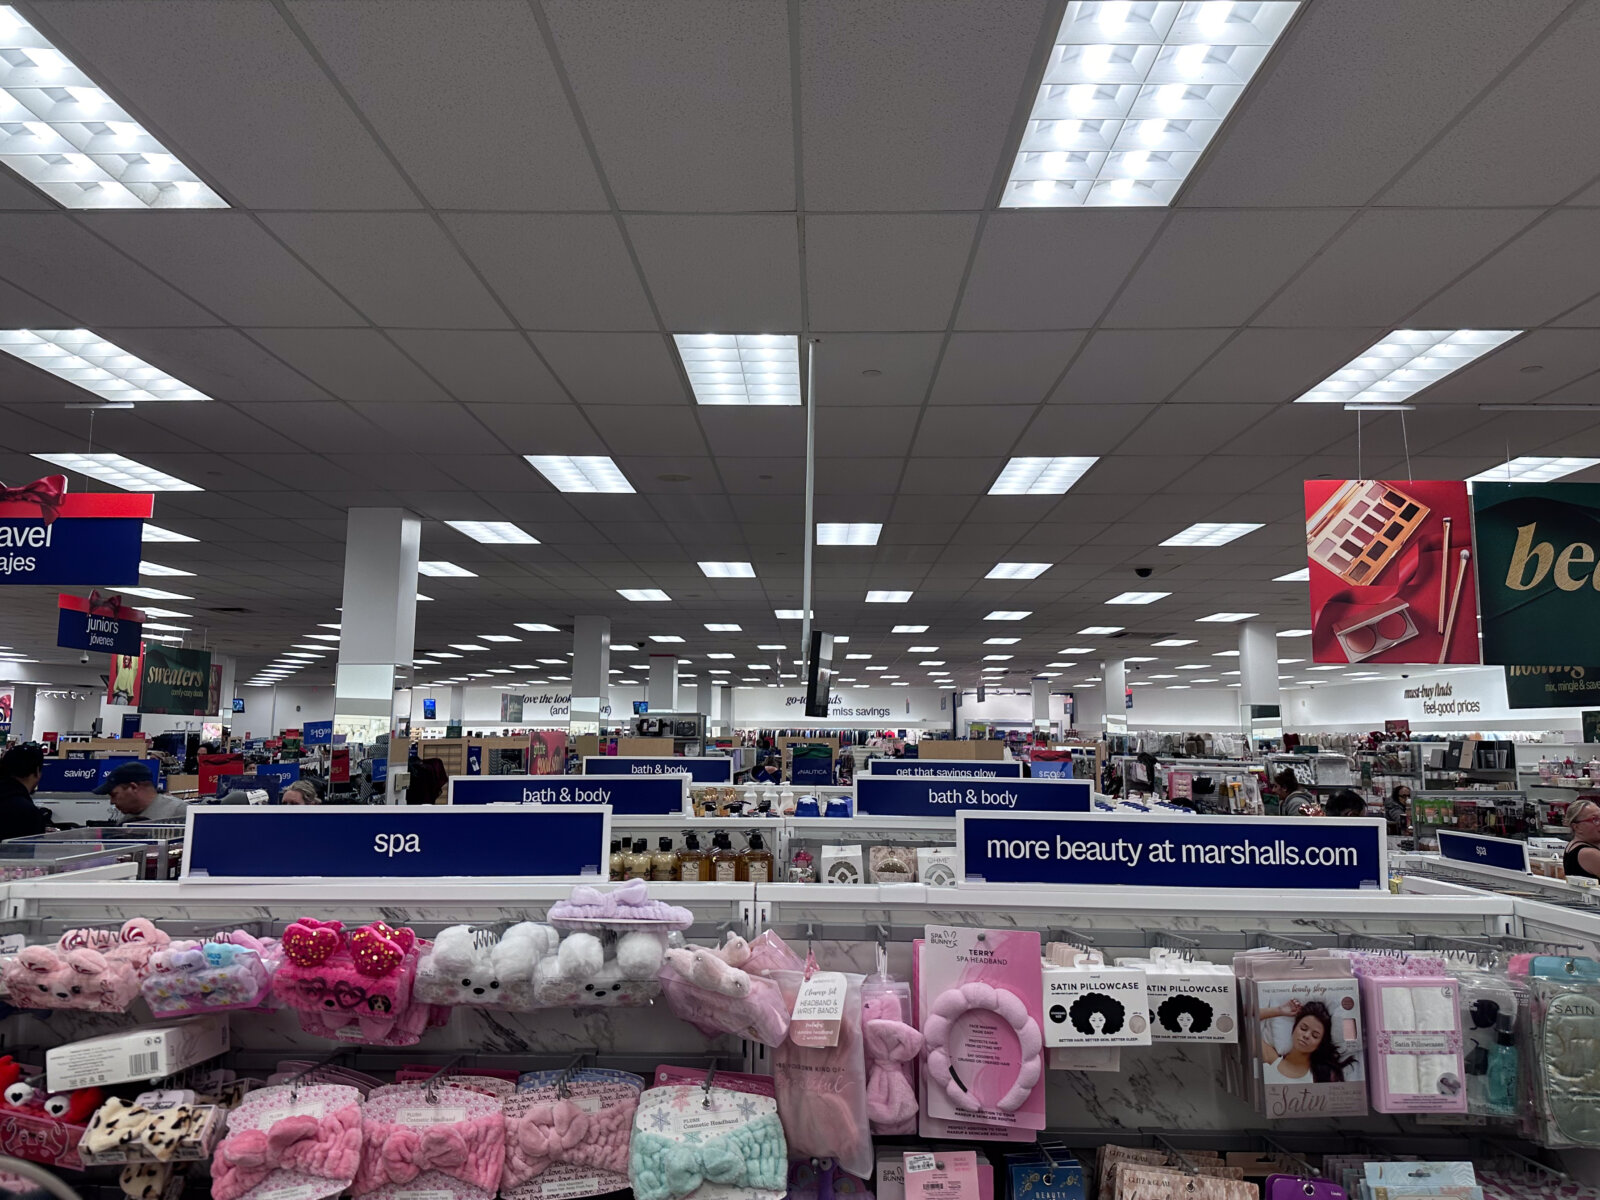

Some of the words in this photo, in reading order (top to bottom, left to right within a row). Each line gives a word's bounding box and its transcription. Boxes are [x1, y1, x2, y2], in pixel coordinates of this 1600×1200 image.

[1505, 522, 1600, 592] be
[86, 614, 119, 634] juniors
[147, 666, 204, 687] sweaters
[1558, 682, 1579, 693] mingle
[1579, 680, 1586, 690] &
[522, 694, 537, 704] love
[539, 694, 553, 704] the
[550, 705, 569, 716] (and
[832, 707, 854, 716] miss
[855, 707, 891, 718] savings
[1423, 701, 1456, 716] feel-good
[1457, 700, 1481, 713] prices
[64, 769, 96, 778] saving?
[631, 764, 652, 774] bath
[654, 764, 662, 774] &
[664, 764, 688, 774] body
[914, 767, 933, 776] that
[523, 788, 556, 802] bath
[559, 788, 571, 802] &
[575, 788, 611, 804] body
[928, 788, 962, 804] bath
[965, 789, 978, 804] &
[981, 790, 1018, 808] body
[373, 833, 421, 857] spa
[1475, 845, 1487, 856] spa
[987, 838, 1050, 859] more
[1055, 835, 1143, 867] beauty
[1148, 840, 1176, 863] at
[1181, 839, 1358, 866] marshalls.com
[969, 949, 994, 957] TERRY
[970, 957, 1008, 966] HEADBAND
[1051, 983, 1077, 991] SATIN
[1080, 982, 1139, 990] PILLOWCASE
[1170, 985, 1229, 993] PILLOWCASE
[1554, 1004, 1595, 1015] SATIN
[1273, 1086, 1326, 1116] Satin
